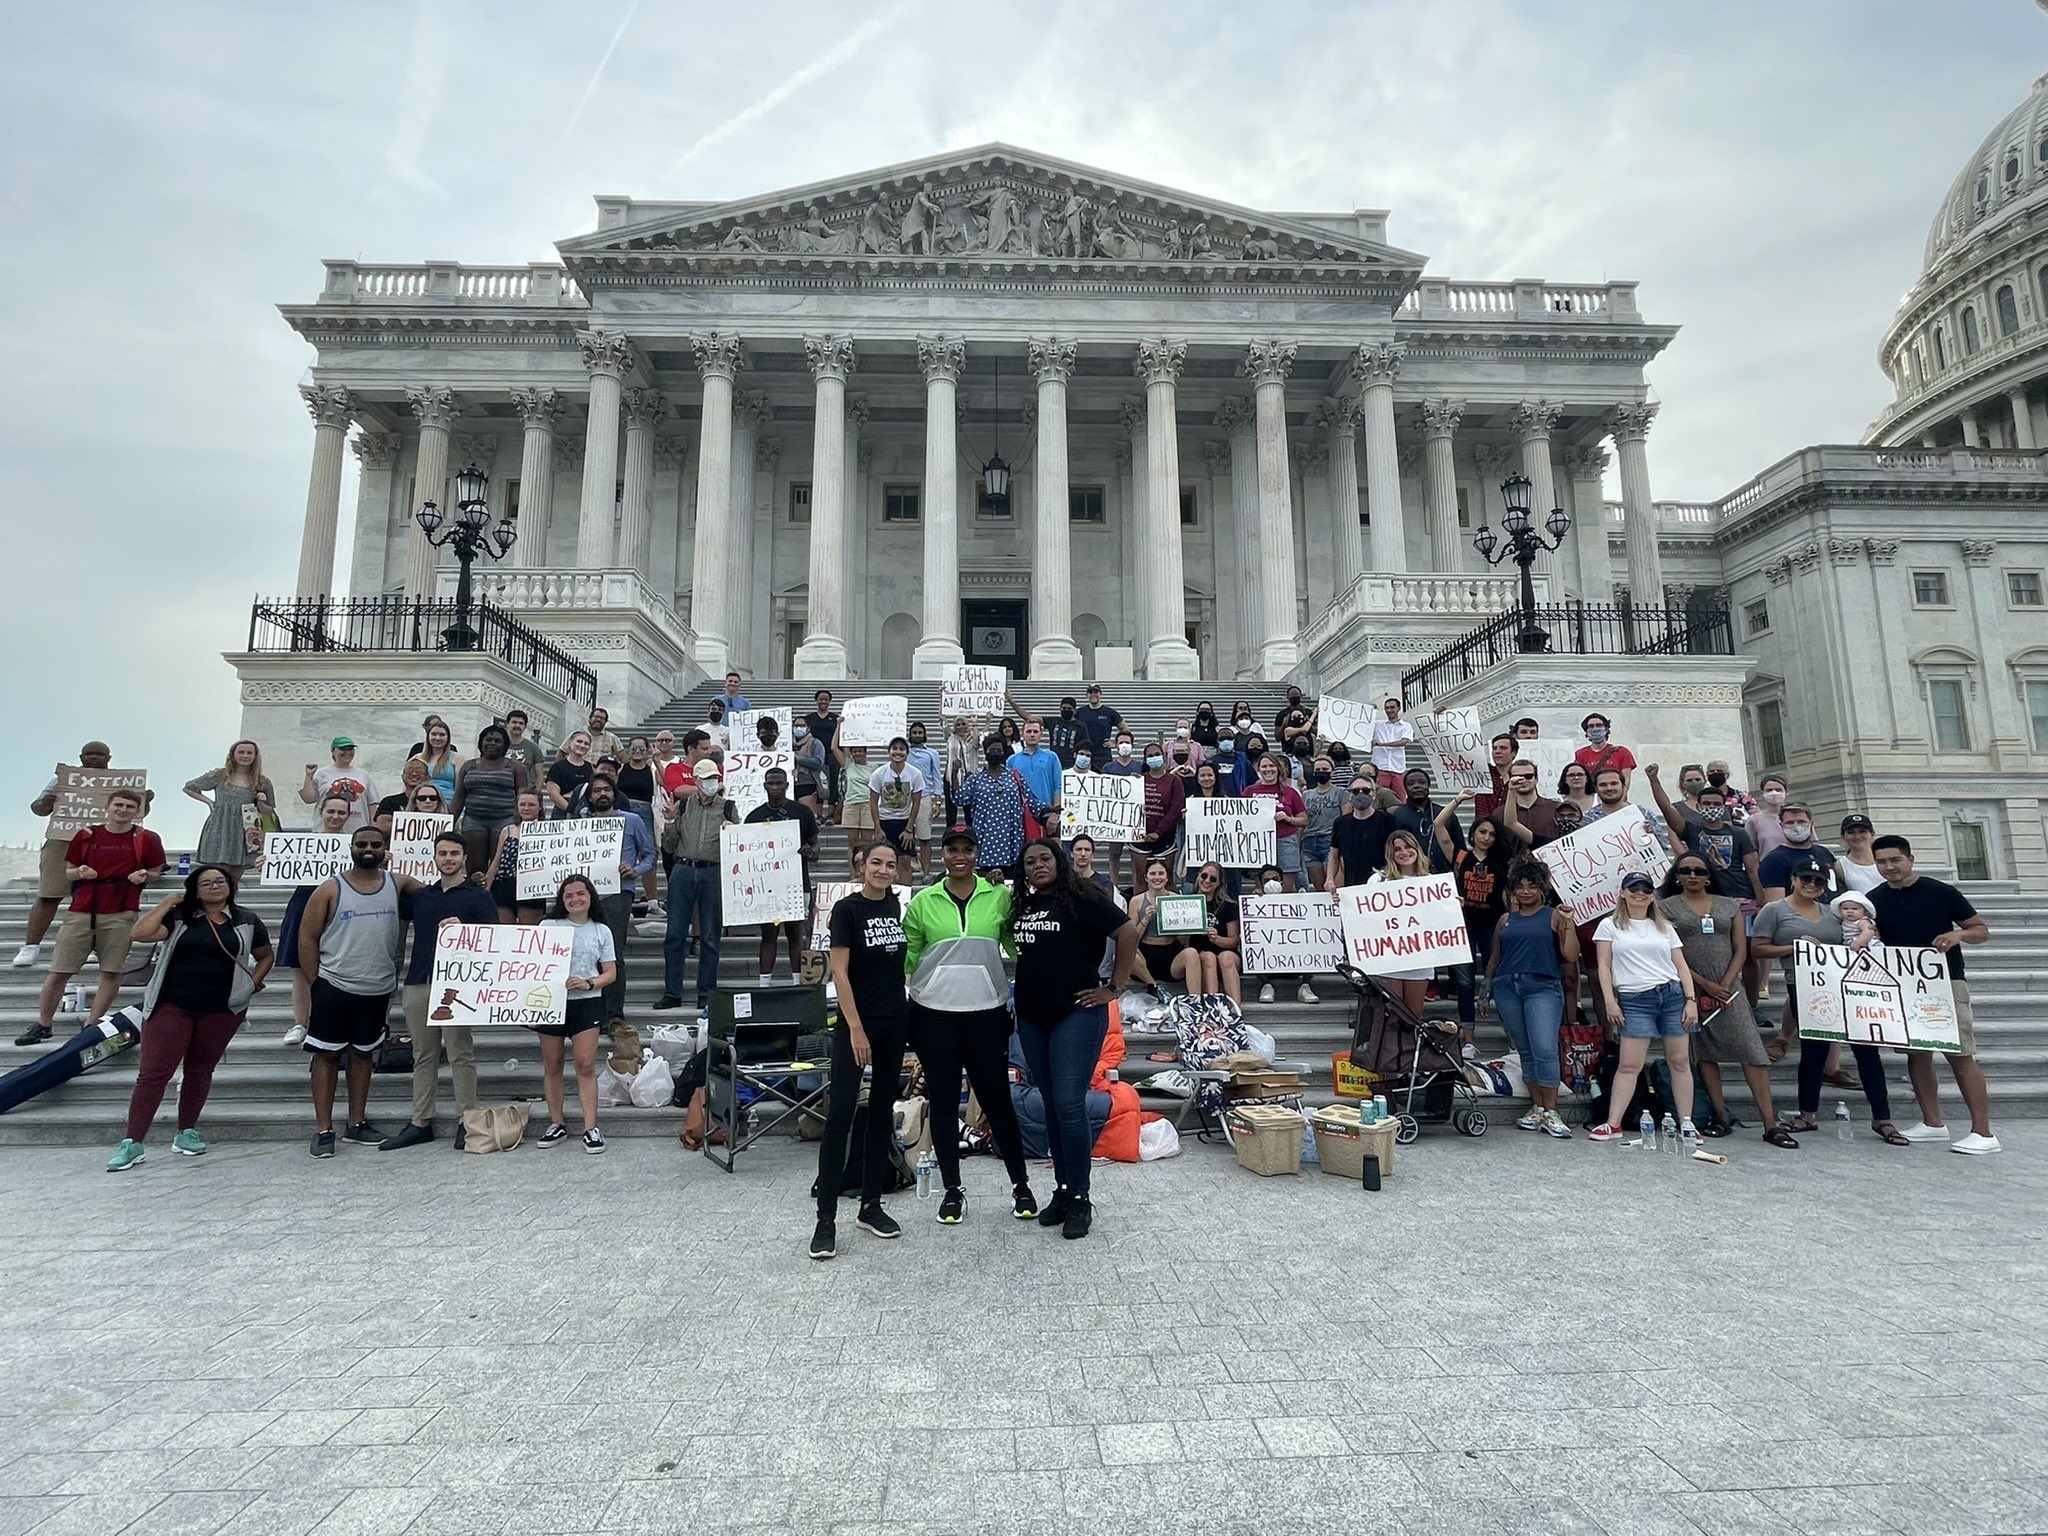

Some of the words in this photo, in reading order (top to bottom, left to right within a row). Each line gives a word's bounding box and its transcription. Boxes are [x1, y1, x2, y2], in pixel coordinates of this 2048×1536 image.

[958, 667, 988, 681] FIGHT
[943, 680, 1000, 693] EVICTIONS
[943, 698, 955, 708] AT
[958, 697, 974, 710] ALL
[976, 695, 1003, 711] COSTS
[1322, 697, 1374, 724] JOIN
[771, 708, 791, 726] THE
[1414, 709, 1470, 737] EVERY
[1328, 716, 1367, 747] US
[1457, 754, 1466, 764] A
[68, 772, 145, 789] EXTEND
[1063, 774, 1132, 800] EXTEND
[1441, 771, 1494, 790] FAILURE
[64, 792, 94, 805] THE
[1203, 799, 1259, 817] HOUSING
[56, 805, 109, 819] EVICT
[1063, 799, 1081, 809] the
[1086, 799, 1145, 828] EVICTION
[520, 820, 565, 834] HOUSING
[568, 819, 578, 832] IS
[580, 819, 589, 830] A
[590, 818, 625, 830] HUMAN
[1061, 825, 1126, 839] MORATORIUM
[1215, 819, 1227, 833] IS
[1234, 820, 1244, 833] A
[270, 836, 341, 855] EXTEND
[421, 846, 432, 856] a
[519, 840, 548, 853] RIGHT.
[549, 837, 571, 850] BUT
[573, 835, 591, 848] ALL
[595, 832, 617, 844] OUR
[728, 832, 776, 860] Housing
[780, 836, 794, 849] is
[1186, 831, 1235, 863] HUMAN
[1238, 830, 1275, 864] RIGHT
[517, 856, 547, 871] REPS
[550, 853, 572, 867] ARE
[576, 849, 599, 862] OUT
[601, 848, 615, 859] OF
[1536, 820, 1653, 889] HOUSING
[265, 860, 354, 880] MORATORIU
[732, 863, 742, 875] a
[747, 858, 790, 874] Human
[1589, 873, 1608, 888] IS
[1616, 863, 1628, 876] A
[1242, 897, 1308, 918] EXTEND
[1313, 903, 1341, 918] THE
[1355, 887, 1452, 915] HOUSING
[864, 928, 875, 938] IS
[874, 927, 887, 937] MY
[886, 926, 904, 935] LOV
[866, 917, 899, 928] POLICY
[1021, 920, 1061, 932] woman
[1386, 917, 1399, 930] IS
[1407, 915, 1420, 928] A
[439, 925, 500, 954] GAVEL
[511, 927, 548, 955] IN
[865, 933, 908, 947] LANGUAG
[1025, 931, 1036, 944] to
[1243, 920, 1344, 945] EVICTION
[1353, 932, 1421, 962] HUMAN
[1424, 926, 1467, 951] RIGHT
[1245, 947, 1346, 971] MORATORIUM
[436, 959, 495, 987] HOUSE,
[497, 960, 560, 983] PEOPLE
[1811, 970, 1826, 987] IS
[1916, 978, 1927, 995] A
[475, 988, 519, 1005] NEED
[1844, 984, 1880, 999] human
[488, 1005, 563, 1025] HOUSING!
